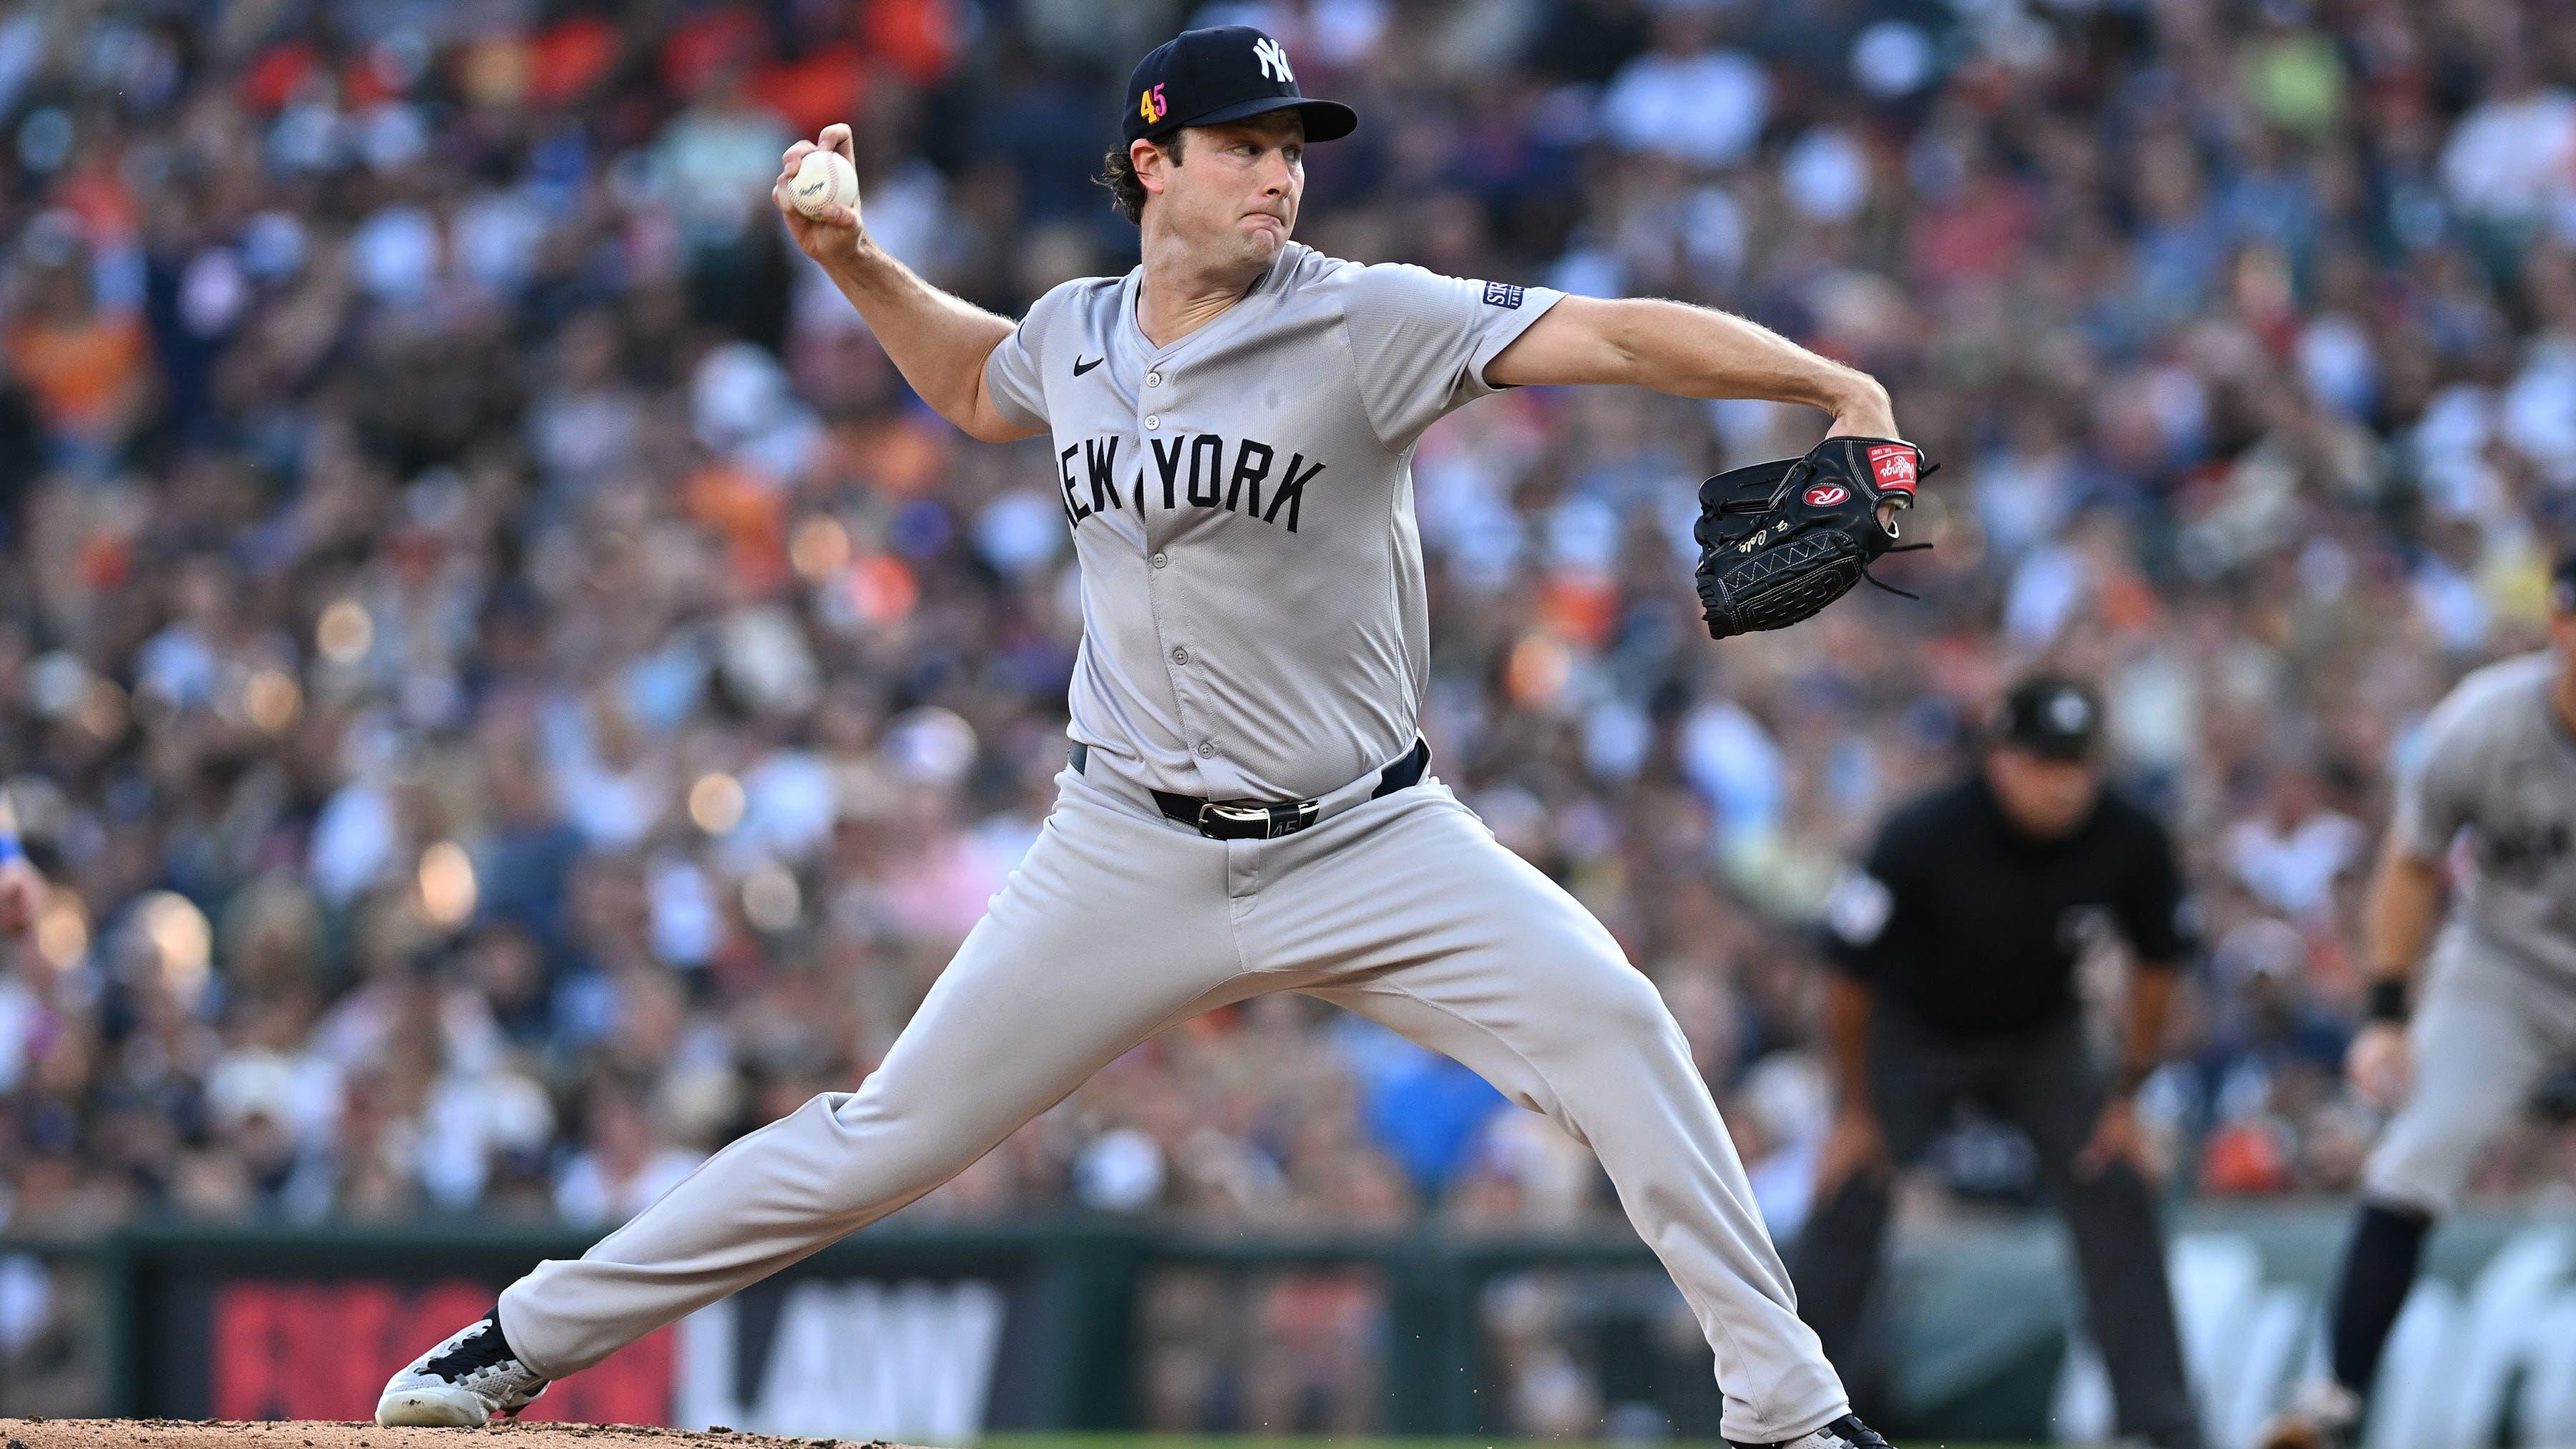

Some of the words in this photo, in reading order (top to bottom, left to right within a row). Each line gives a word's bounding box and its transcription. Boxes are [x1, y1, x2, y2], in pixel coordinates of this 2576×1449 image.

[1252, 37, 1294, 82] NY
[1140, 82, 1167, 125] 45
[1151, 434, 1326, 533] YORK
[1880, 459, 1915, 480] Rawlings
[1738, 530, 1767, 553] Cole
[1271, 819, 1298, 837] 45
